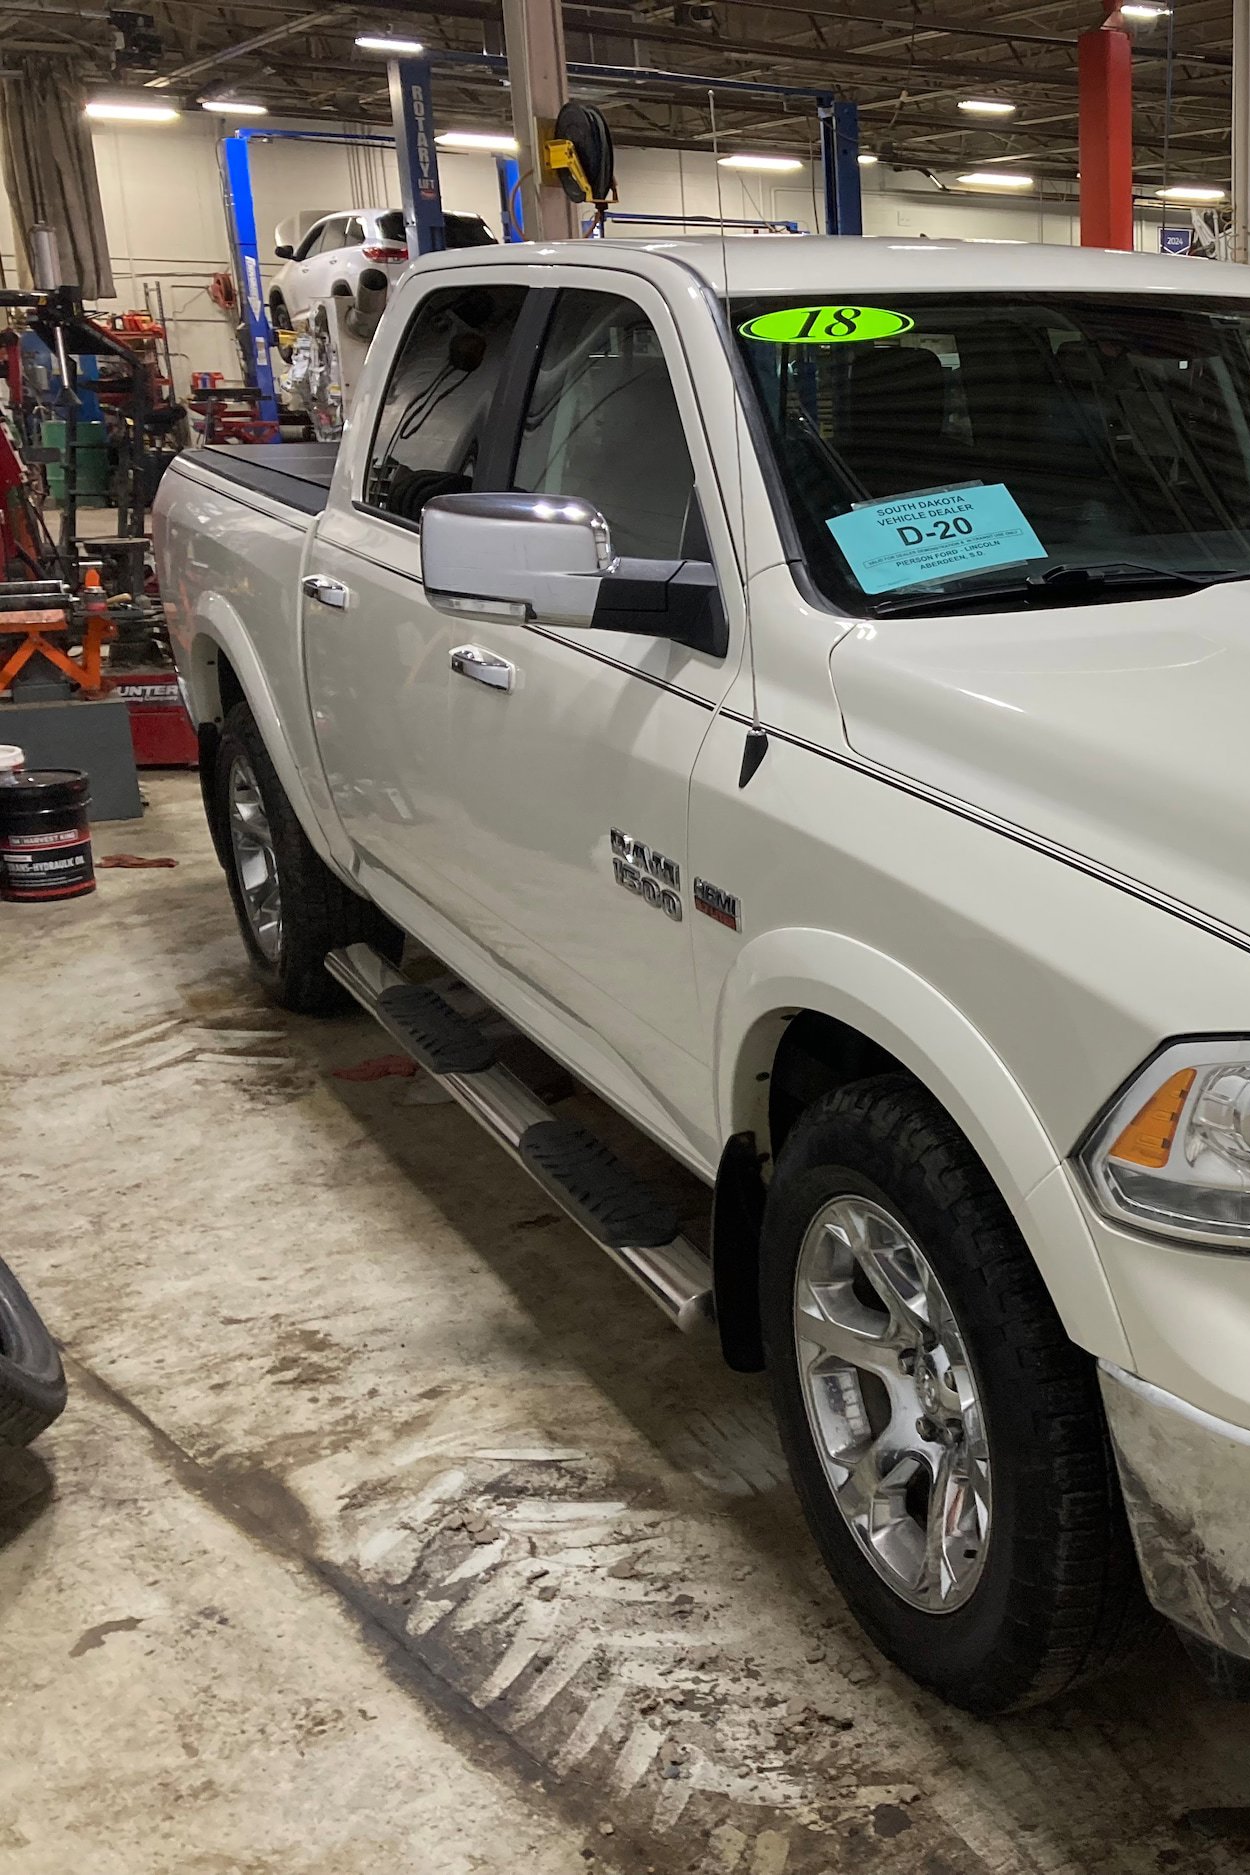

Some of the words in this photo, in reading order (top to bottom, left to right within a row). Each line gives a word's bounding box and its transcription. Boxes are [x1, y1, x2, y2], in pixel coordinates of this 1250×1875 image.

[411, 84, 431, 178] ROTARY
[418, 178, 434, 190] LIFT
[1166, 236, 1183, 246] 2024
[789, 308, 862, 338] 18
[876, 502, 917, 517] SOUTH
[918, 495, 965, 510] DAKOTA
[876, 511, 928, 527] VEHICLE
[928, 503, 974, 518] DEALER
[896, 517, 973, 546] D-20
[896, 554, 933, 567] PIERSON
[934, 548, 958, 560] FORD
[964, 540, 1001, 553] LINCOLN
[116, 684, 179, 697] UNTER
[23, 835, 59, 844] HARVEST
[611, 826, 680, 893] RAM
[613, 857, 683, 922] 1500
[694, 876, 740, 919] HEMI
